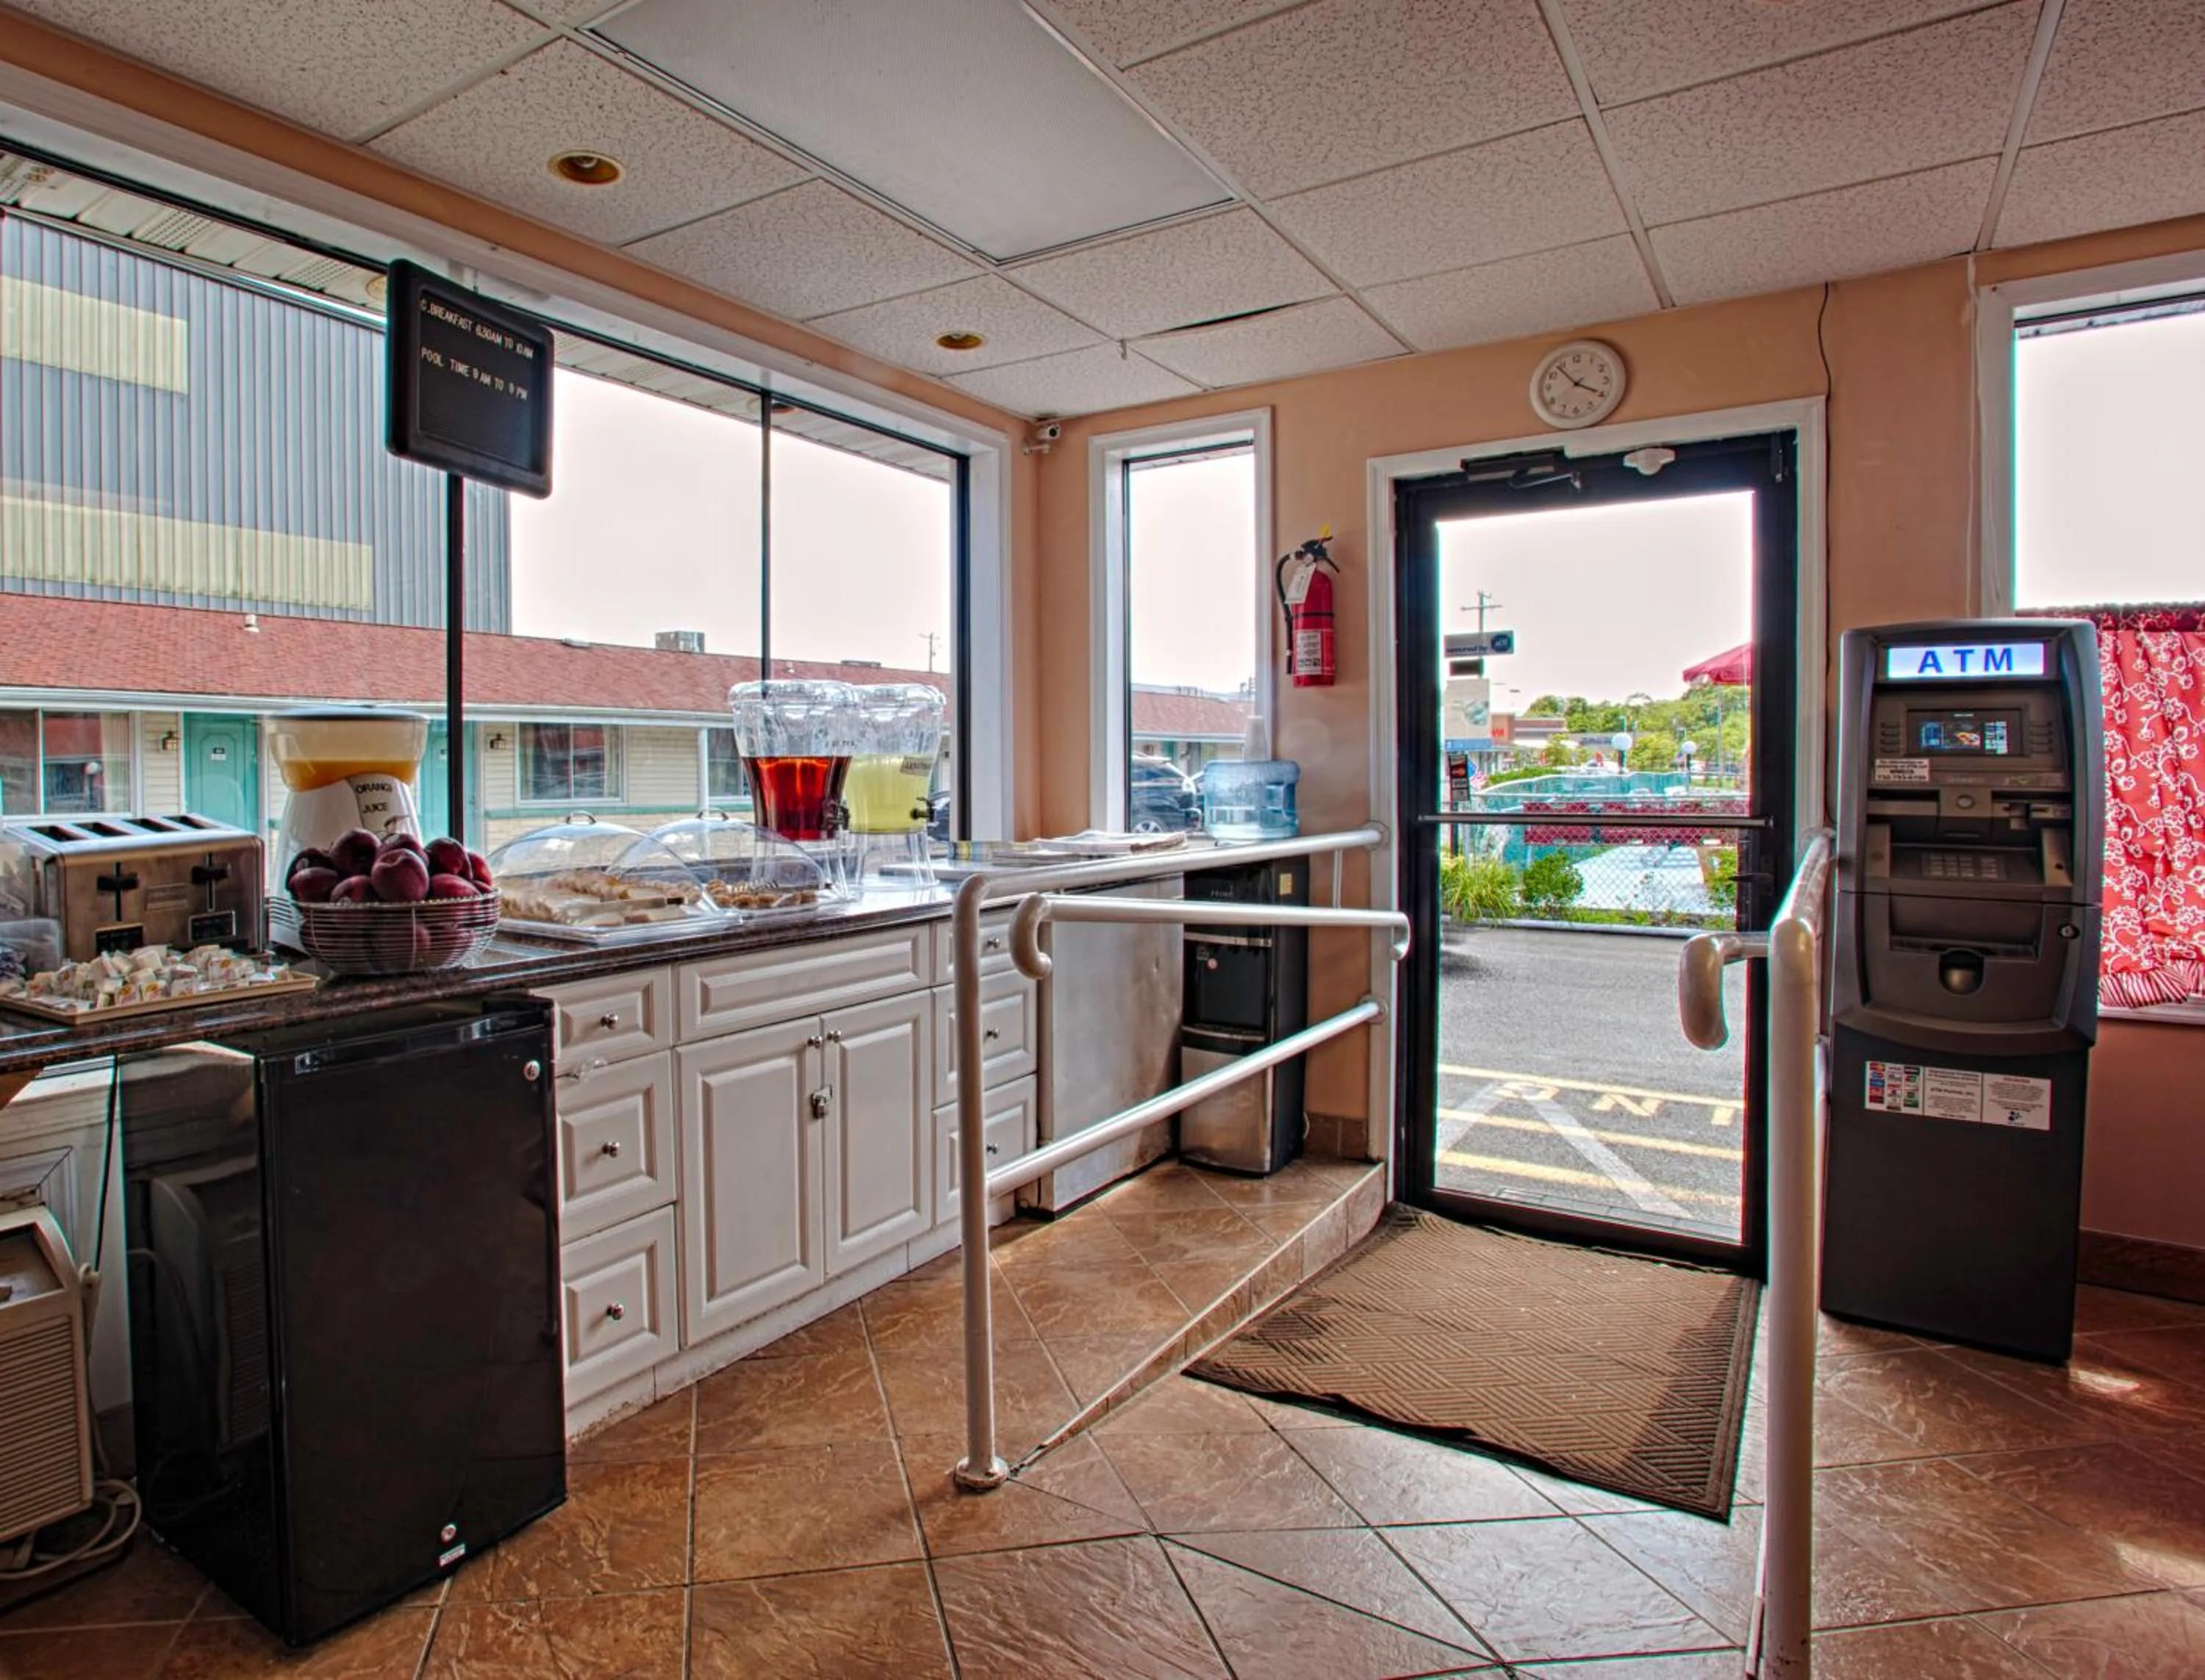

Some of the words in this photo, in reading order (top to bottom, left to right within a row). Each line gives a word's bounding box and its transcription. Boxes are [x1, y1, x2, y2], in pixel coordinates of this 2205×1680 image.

[504, 336, 514, 349] TO
[421, 345, 444, 367] POOL
[450, 358, 470, 377] TIME
[480, 371, 491, 387] AM
[494, 376, 505, 392] TO
[1918, 647, 2013, 673] ATM
[362, 802, 389, 814] JUICE
